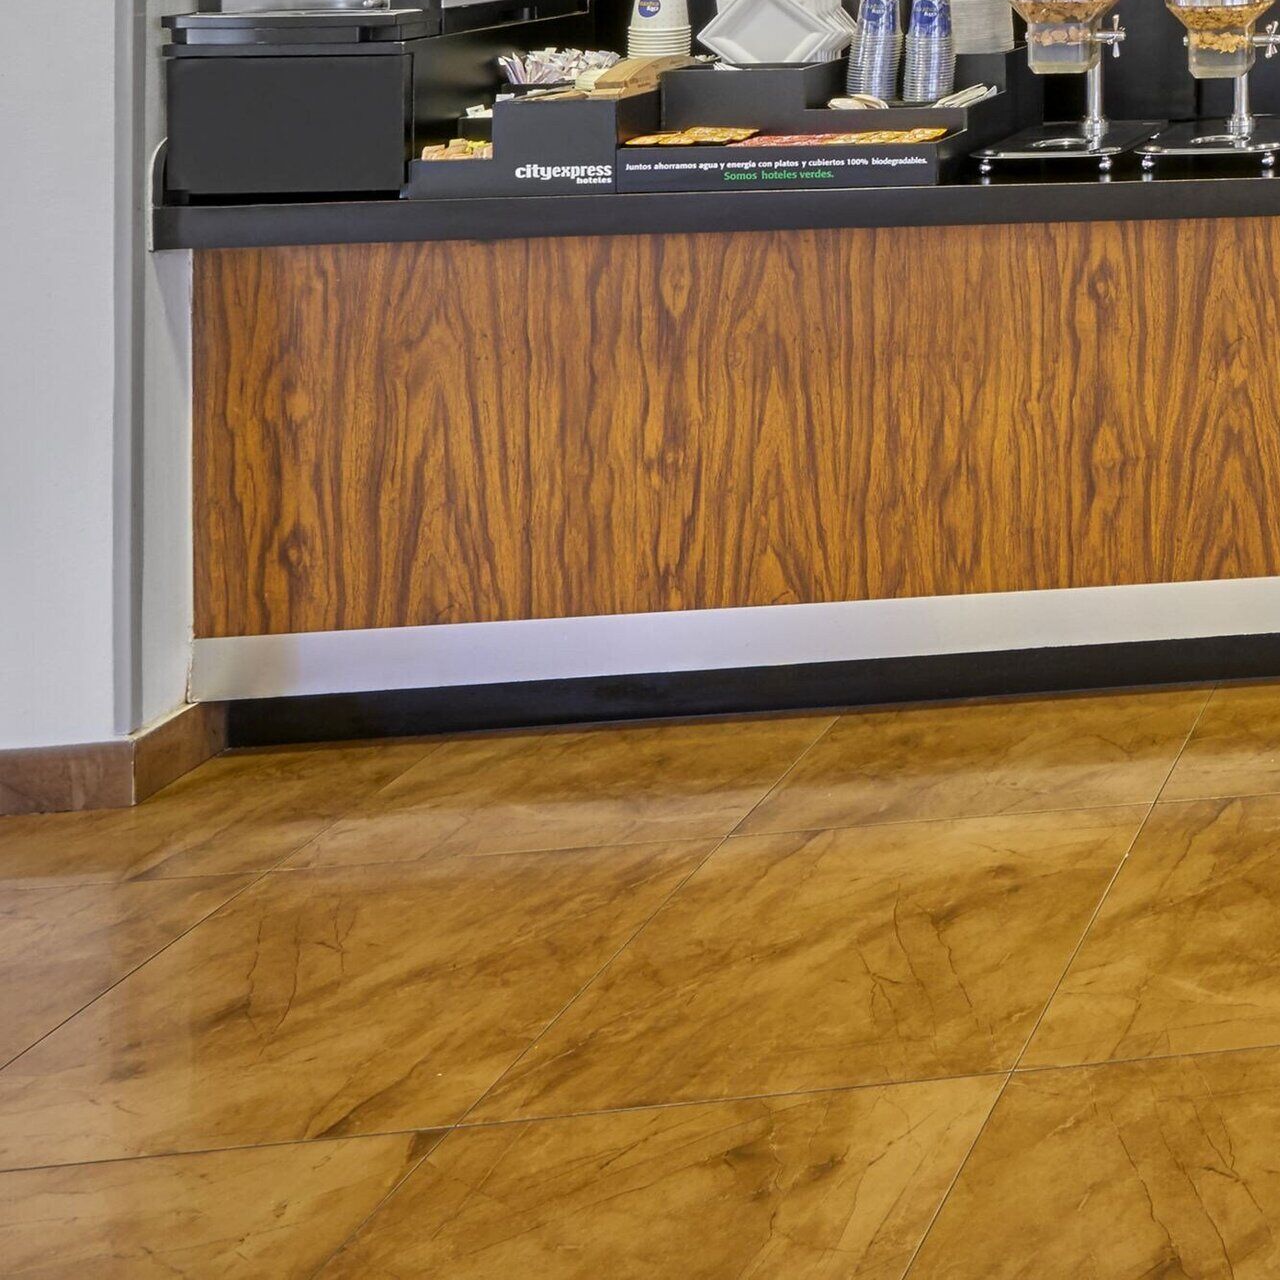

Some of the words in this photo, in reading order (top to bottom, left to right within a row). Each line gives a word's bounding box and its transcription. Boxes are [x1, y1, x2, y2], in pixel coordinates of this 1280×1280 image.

[625, 163, 652, 171] Juntos
[653, 161, 697, 170] ahorramos
[698, 162, 719, 171] agua
[720, 161, 725, 170] y
[726, 159, 757, 170] energía
[758, 160, 773, 168] con
[774, 159, 799, 169] platos
[801, 160, 807, 169] y
[808, 158, 845, 167] cubiertos
[847, 158, 869, 166] 100%
[871, 156, 928, 166] biodegradables.
[515, 163, 613, 181] cityexpress
[723, 171, 758, 181] Somos
[761, 170, 798, 180] hoteles
[799, 169, 834, 180] verdes.
[576, 176, 613, 185] hoteles
